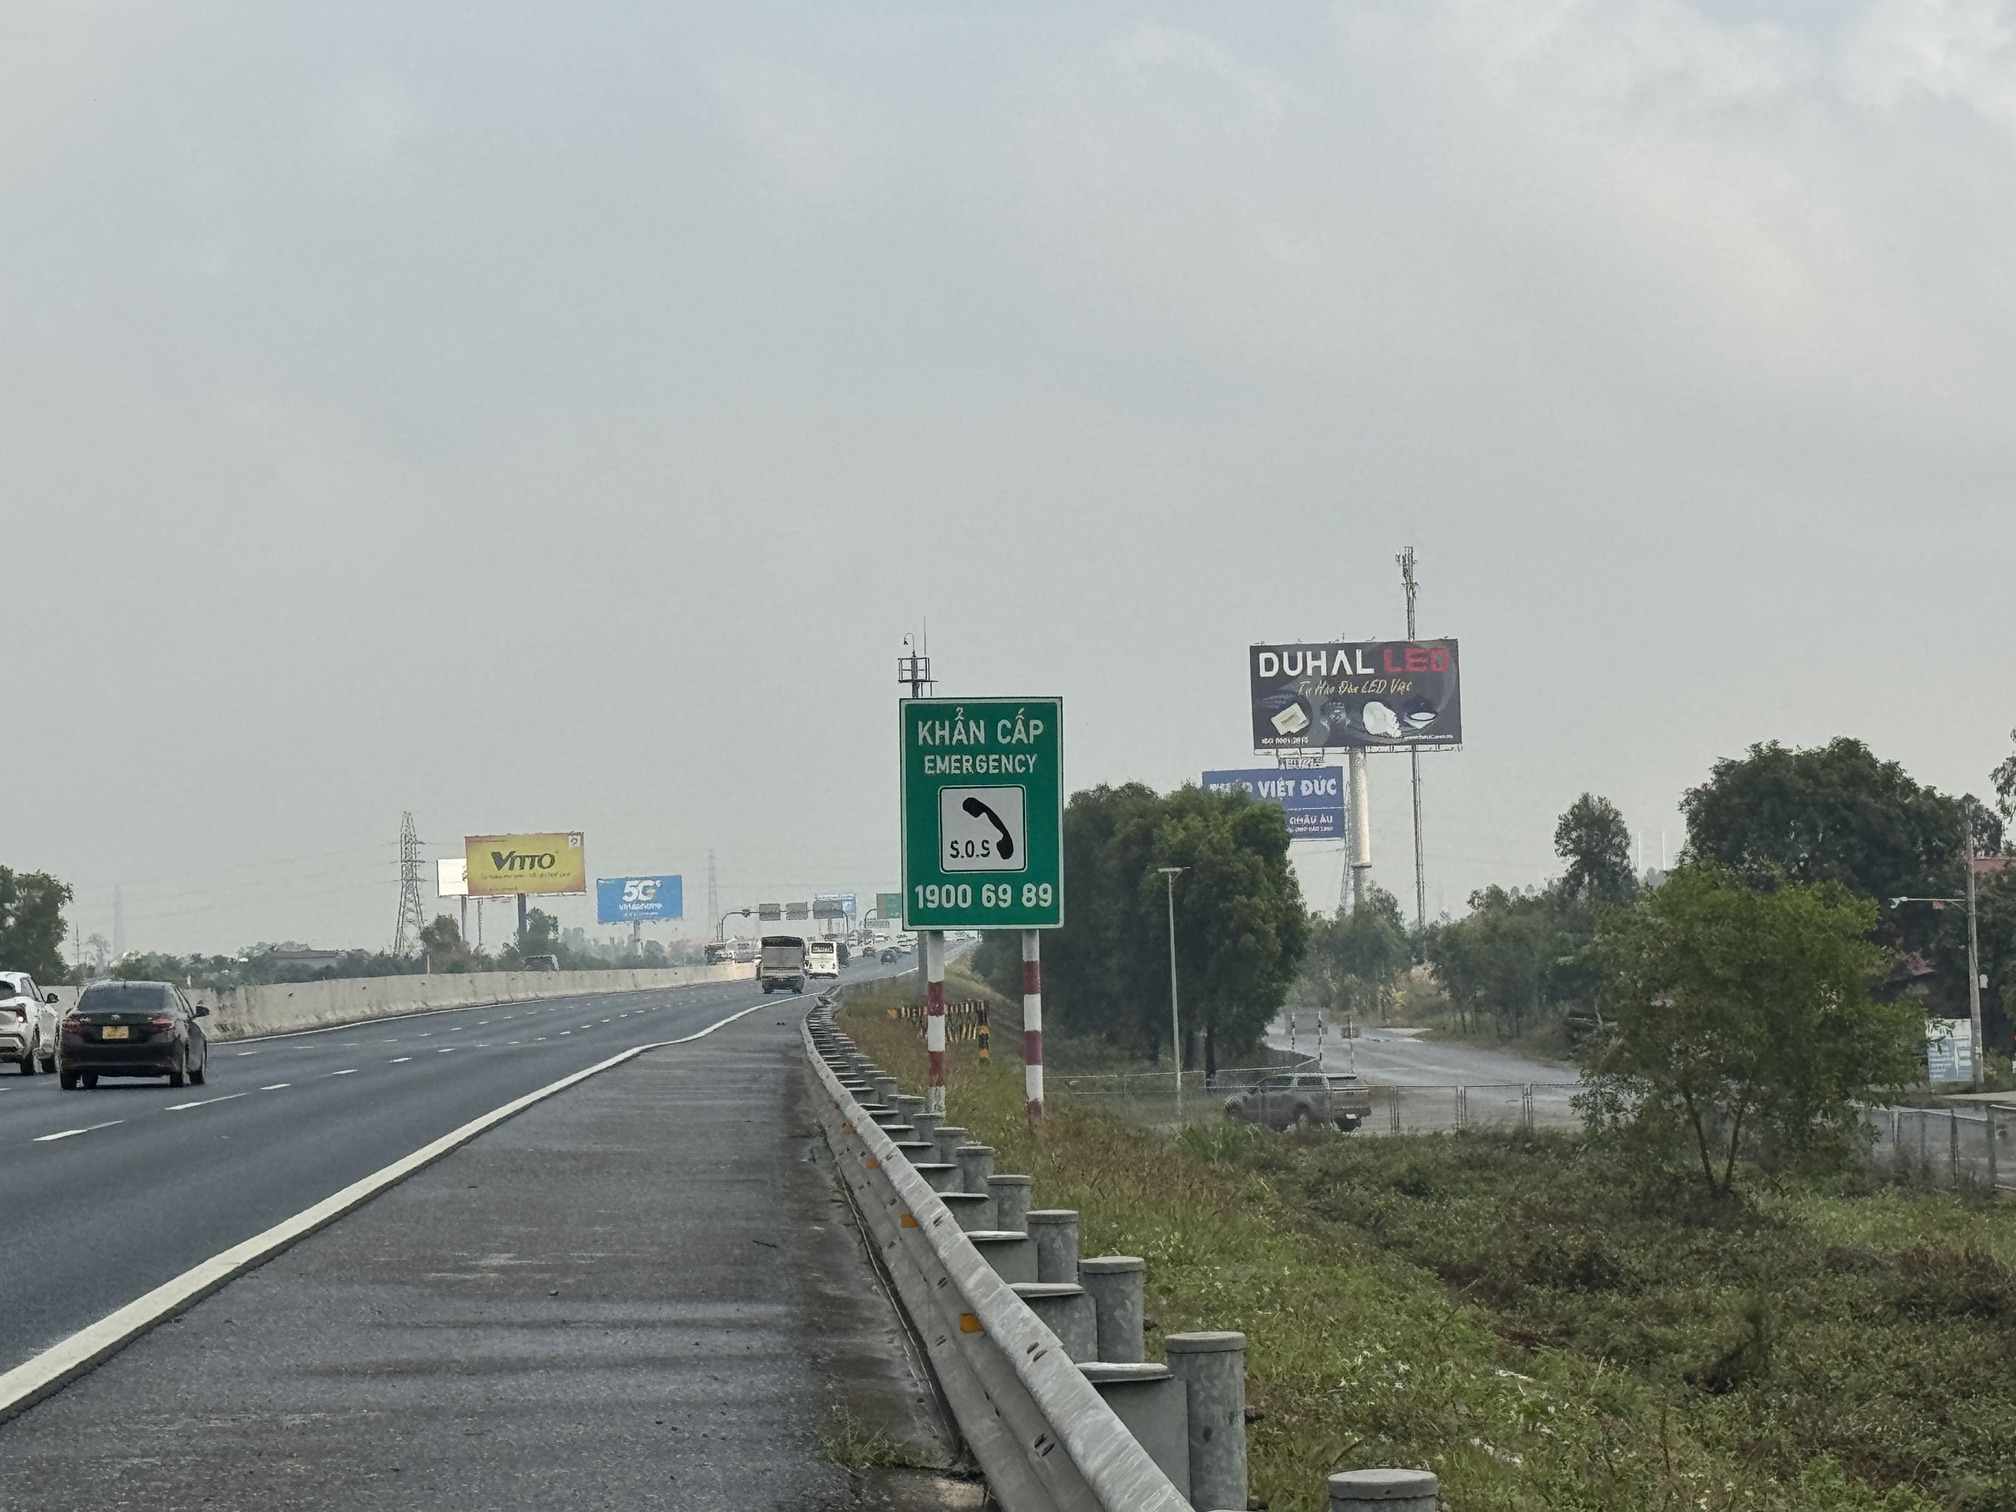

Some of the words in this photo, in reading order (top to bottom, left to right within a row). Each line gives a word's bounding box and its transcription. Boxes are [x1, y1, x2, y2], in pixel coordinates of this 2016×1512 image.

[1259, 649, 1375, 678] DUHAL
[1383, 647, 1450, 673] LED
[1361, 679, 1387, 694] LED
[918, 707, 985, 746] KHẨN
[997, 708, 1044, 745] CẤP
[924, 754, 1038, 775] EMERGENCY
[1257, 777, 1296, 801] VIỆT
[1301, 775, 1337, 797] ĐỨC
[491, 850, 556, 871] VITTO
[950, 840, 991, 859] S.O.S
[915, 884, 972, 909] 1900
[981, 883, 1012, 908] 69
[1021, 883, 1053, 908] 89
